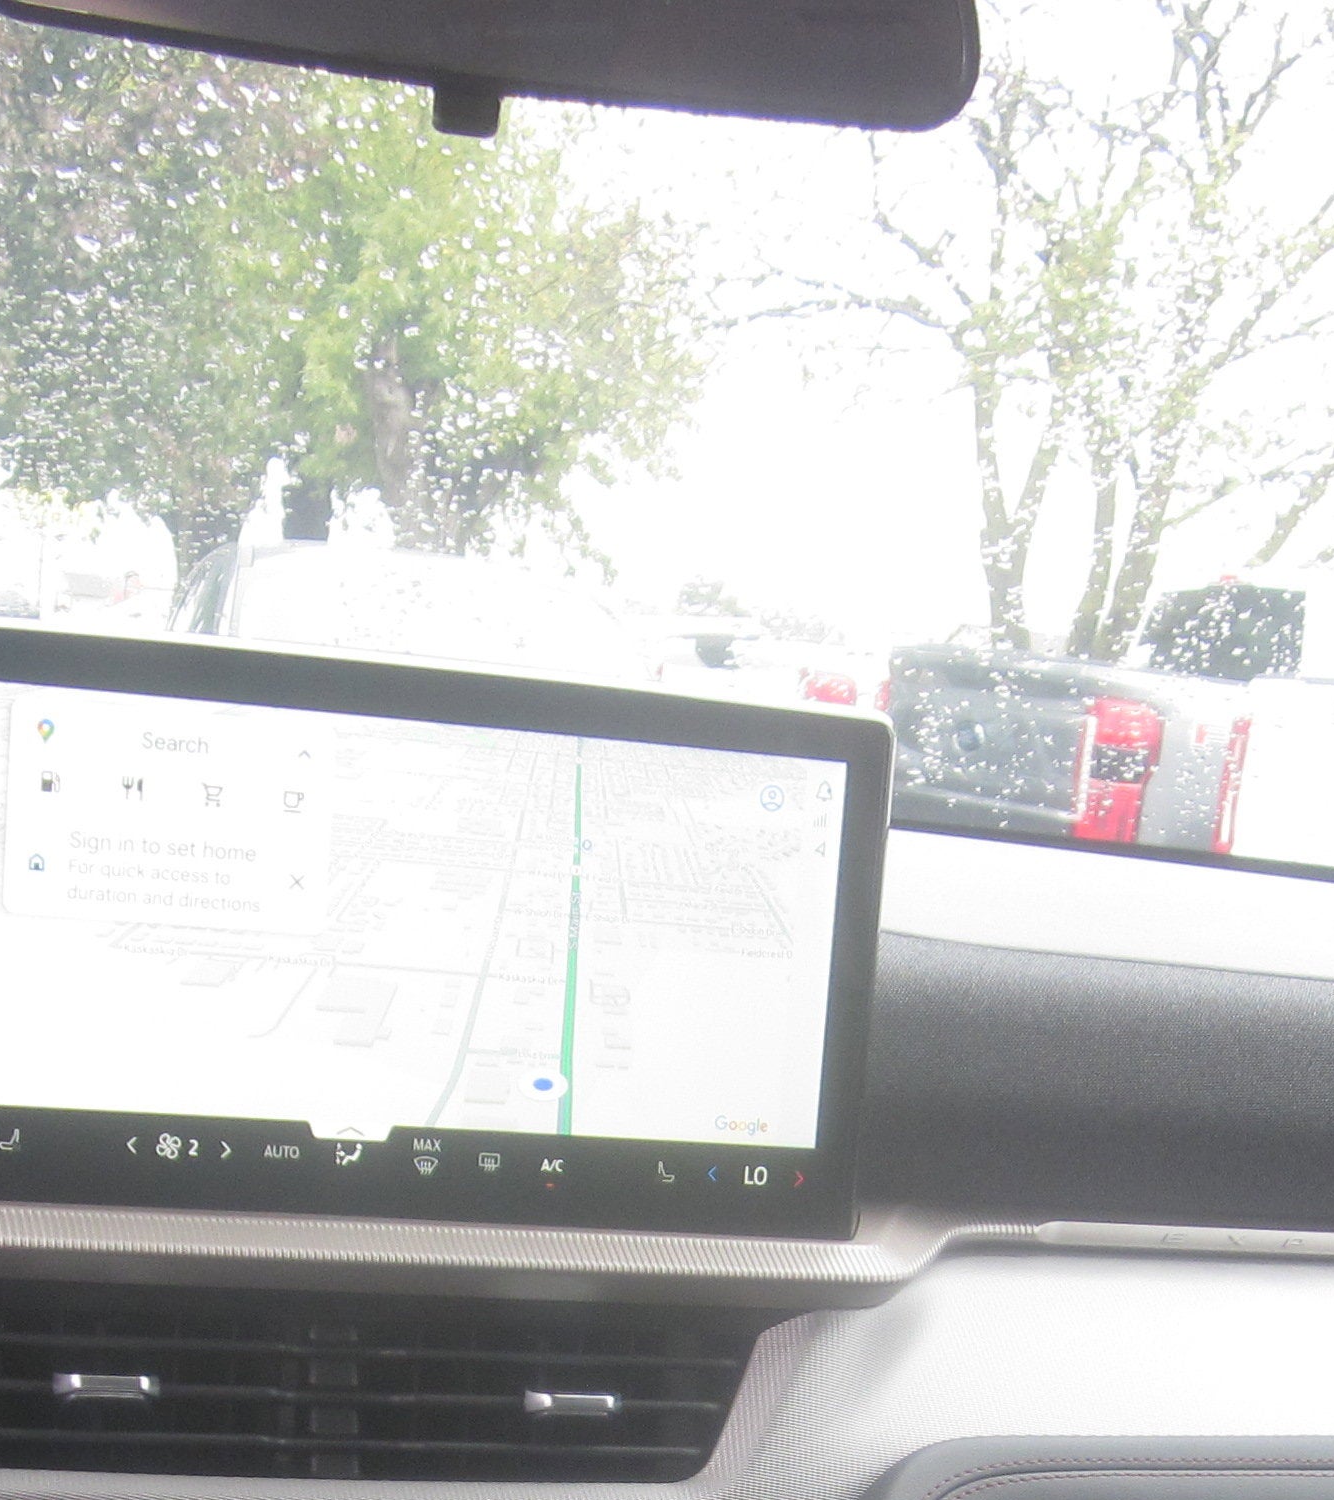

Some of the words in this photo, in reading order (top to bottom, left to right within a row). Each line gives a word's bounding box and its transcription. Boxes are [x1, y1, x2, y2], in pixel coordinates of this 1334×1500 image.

[141, 731, 210, 754] Search
[69, 832, 111, 855] Sign
[117, 835, 135, 852] in
[141, 838, 161, 855] to
[167, 842, 196, 858] set
[202, 841, 257, 863] home
[68, 859, 95, 875] For
[101, 863, 144, 883] quick
[151, 868, 208, 884] access
[215, 871, 231, 886] to
[67, 885, 136, 905] duration
[142, 888, 173, 907] and
[178, 891, 261, 913] directions
[715, 1114, 768, 1136] Google
[188, 1139, 198, 1156] 2
[264, 1144, 300, 1159] AUTO
[413, 1137, 441, 1153] MAX
[540, 1157, 564, 1173] A/C
[744, 1165, 768, 1186] LO
